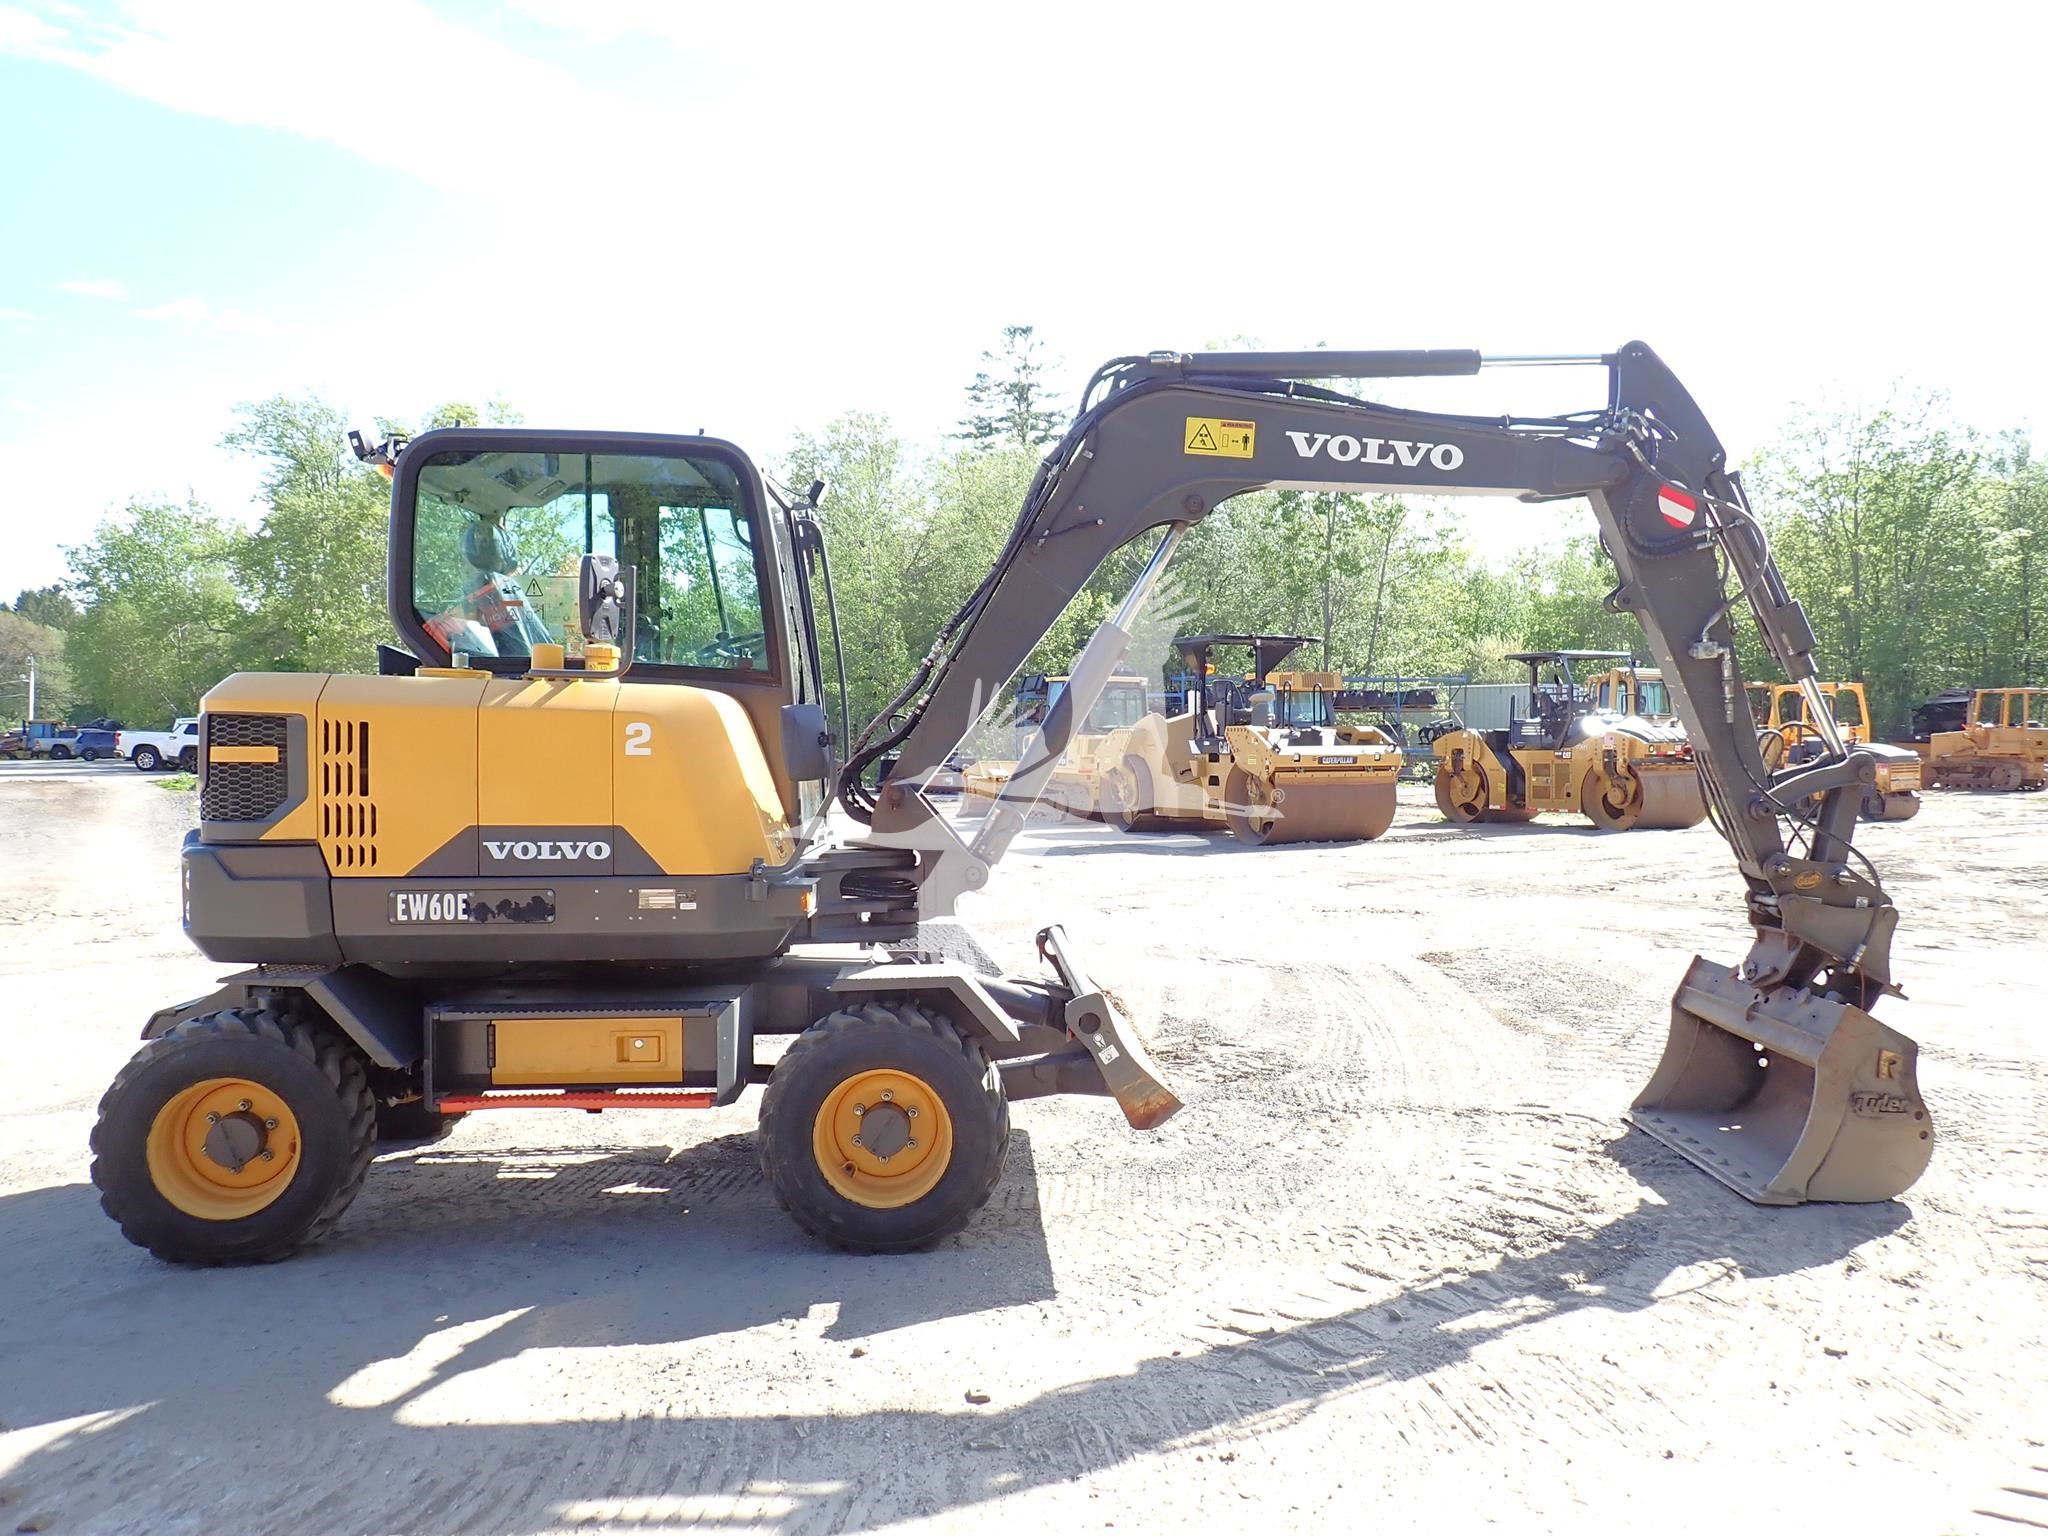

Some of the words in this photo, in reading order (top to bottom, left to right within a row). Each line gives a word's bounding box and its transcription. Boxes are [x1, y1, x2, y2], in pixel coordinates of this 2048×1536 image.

[1285, 431, 1464, 470] VOLVO
[624, 722, 652, 756] 2
[1322, 756, 1353, 764] CATERPILLAR
[482, 841, 611, 860] VOLVO
[397, 893, 469, 921] EW60E
